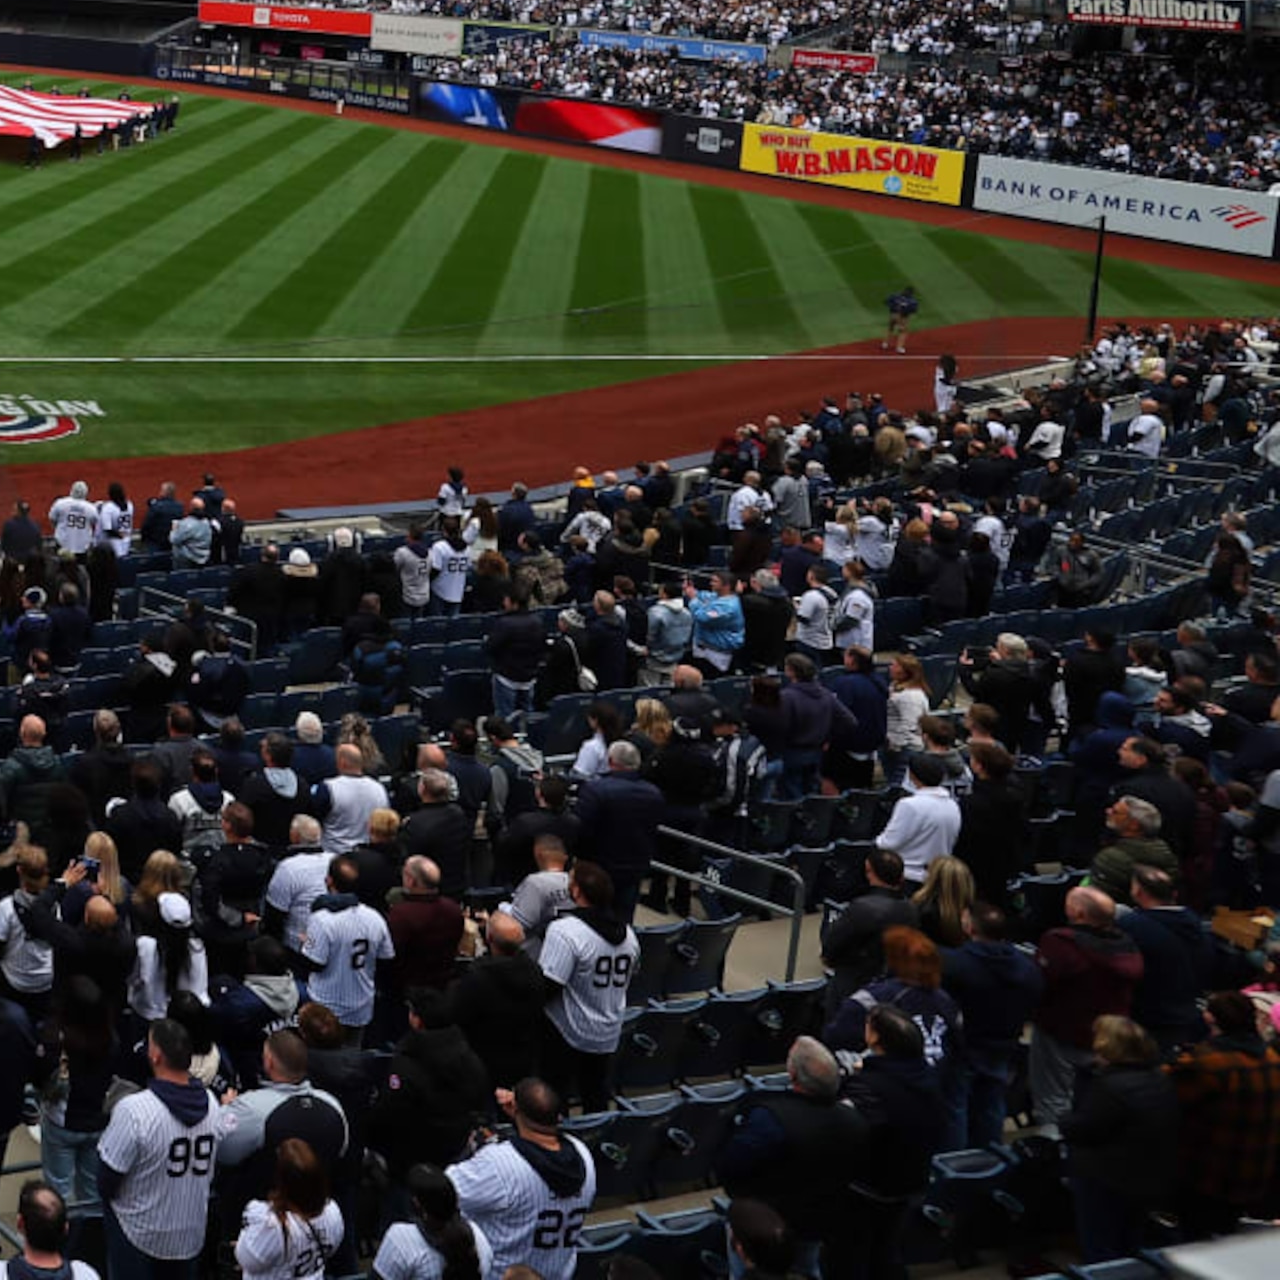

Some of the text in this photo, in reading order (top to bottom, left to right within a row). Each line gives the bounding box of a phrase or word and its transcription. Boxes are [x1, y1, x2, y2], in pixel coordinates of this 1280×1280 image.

[273, 13, 311, 24] TOYOTA
[760, 132, 813, 149] WHO BUY
[981, 176, 1202, 222] BANK OF AMERICA
[27, 400, 106, 417] DAY
[418, 561, 428, 575] 2
[448, 558, 467, 572] 22
[351, 938, 370, 970] 2
[593, 954, 632, 988] 99
[167, 1135, 215, 1177] 99
[533, 1207, 589, 1250] 22
